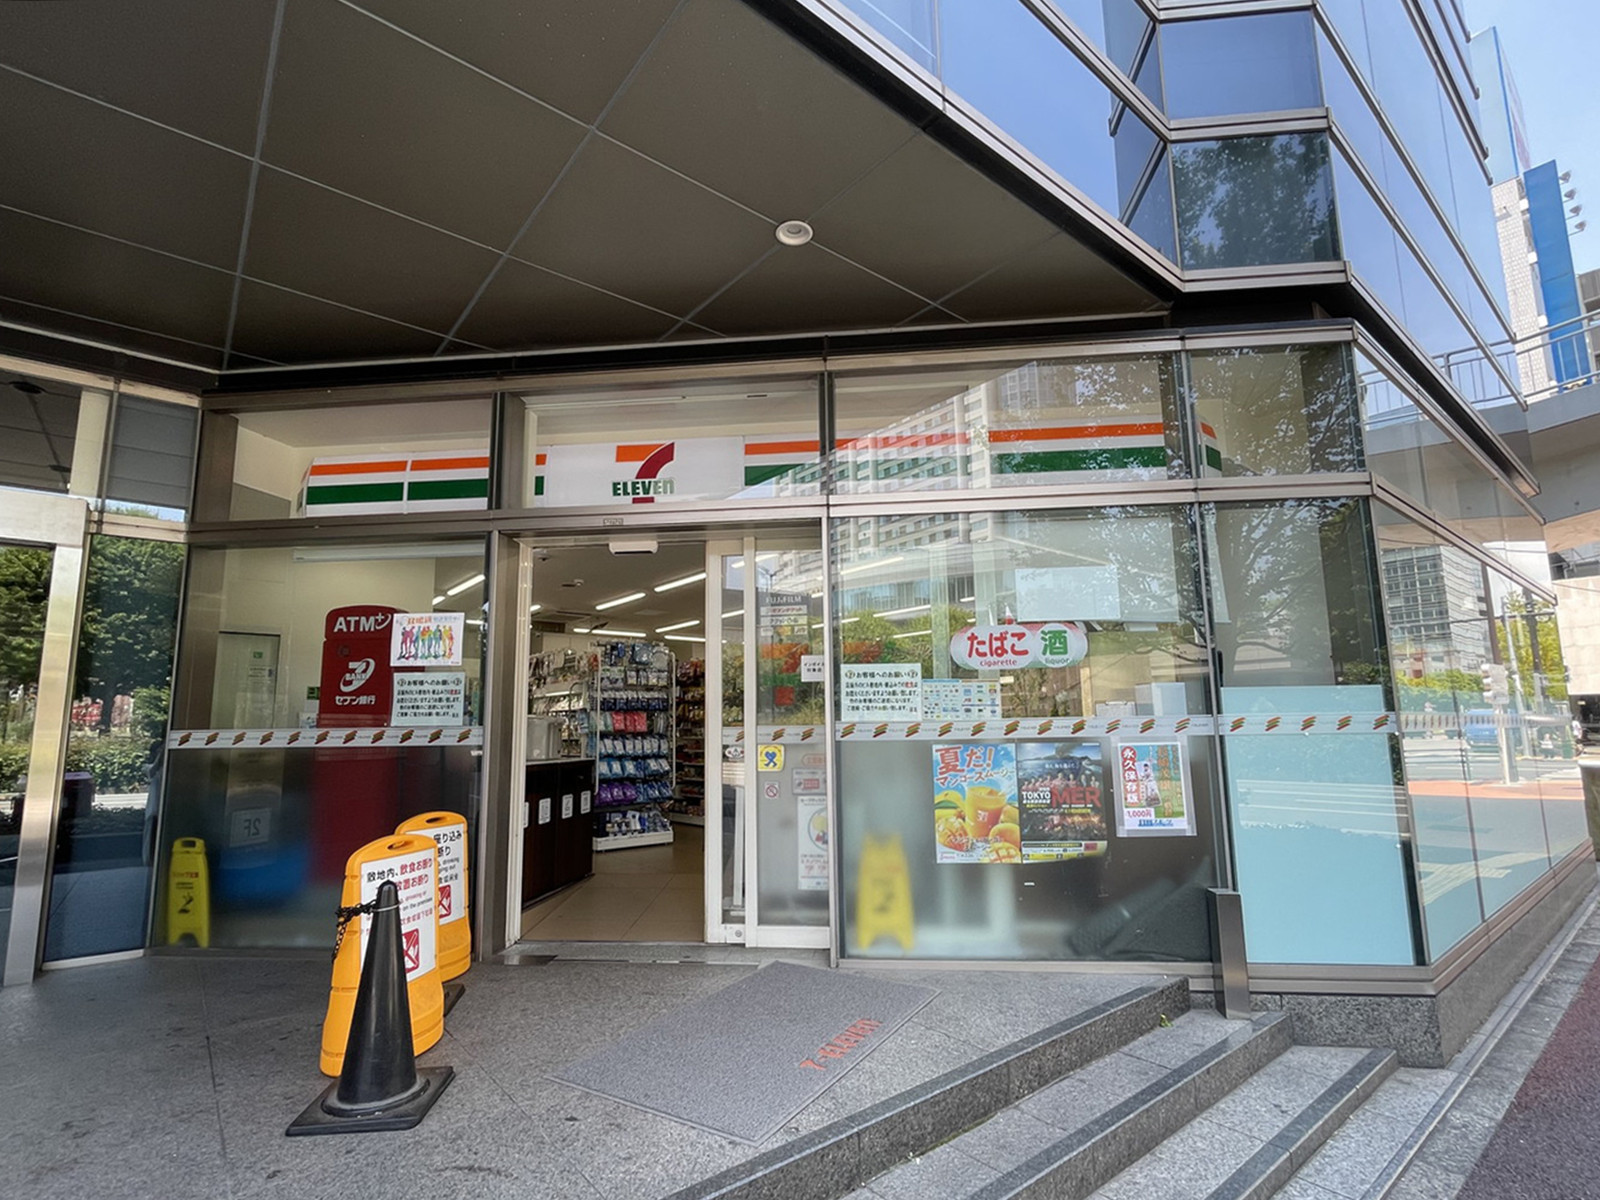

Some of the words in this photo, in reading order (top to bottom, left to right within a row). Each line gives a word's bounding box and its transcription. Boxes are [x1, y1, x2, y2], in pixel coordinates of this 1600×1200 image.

[333, 616, 375, 633] ATM
[967, 630, 1029, 659] たばこ
[1040, 629, 1069, 656] 酒
[980, 659, 1017, 668] cigarette
[1022, 791, 1051, 800] TOKYO
[1051, 785, 1102, 808] MER
